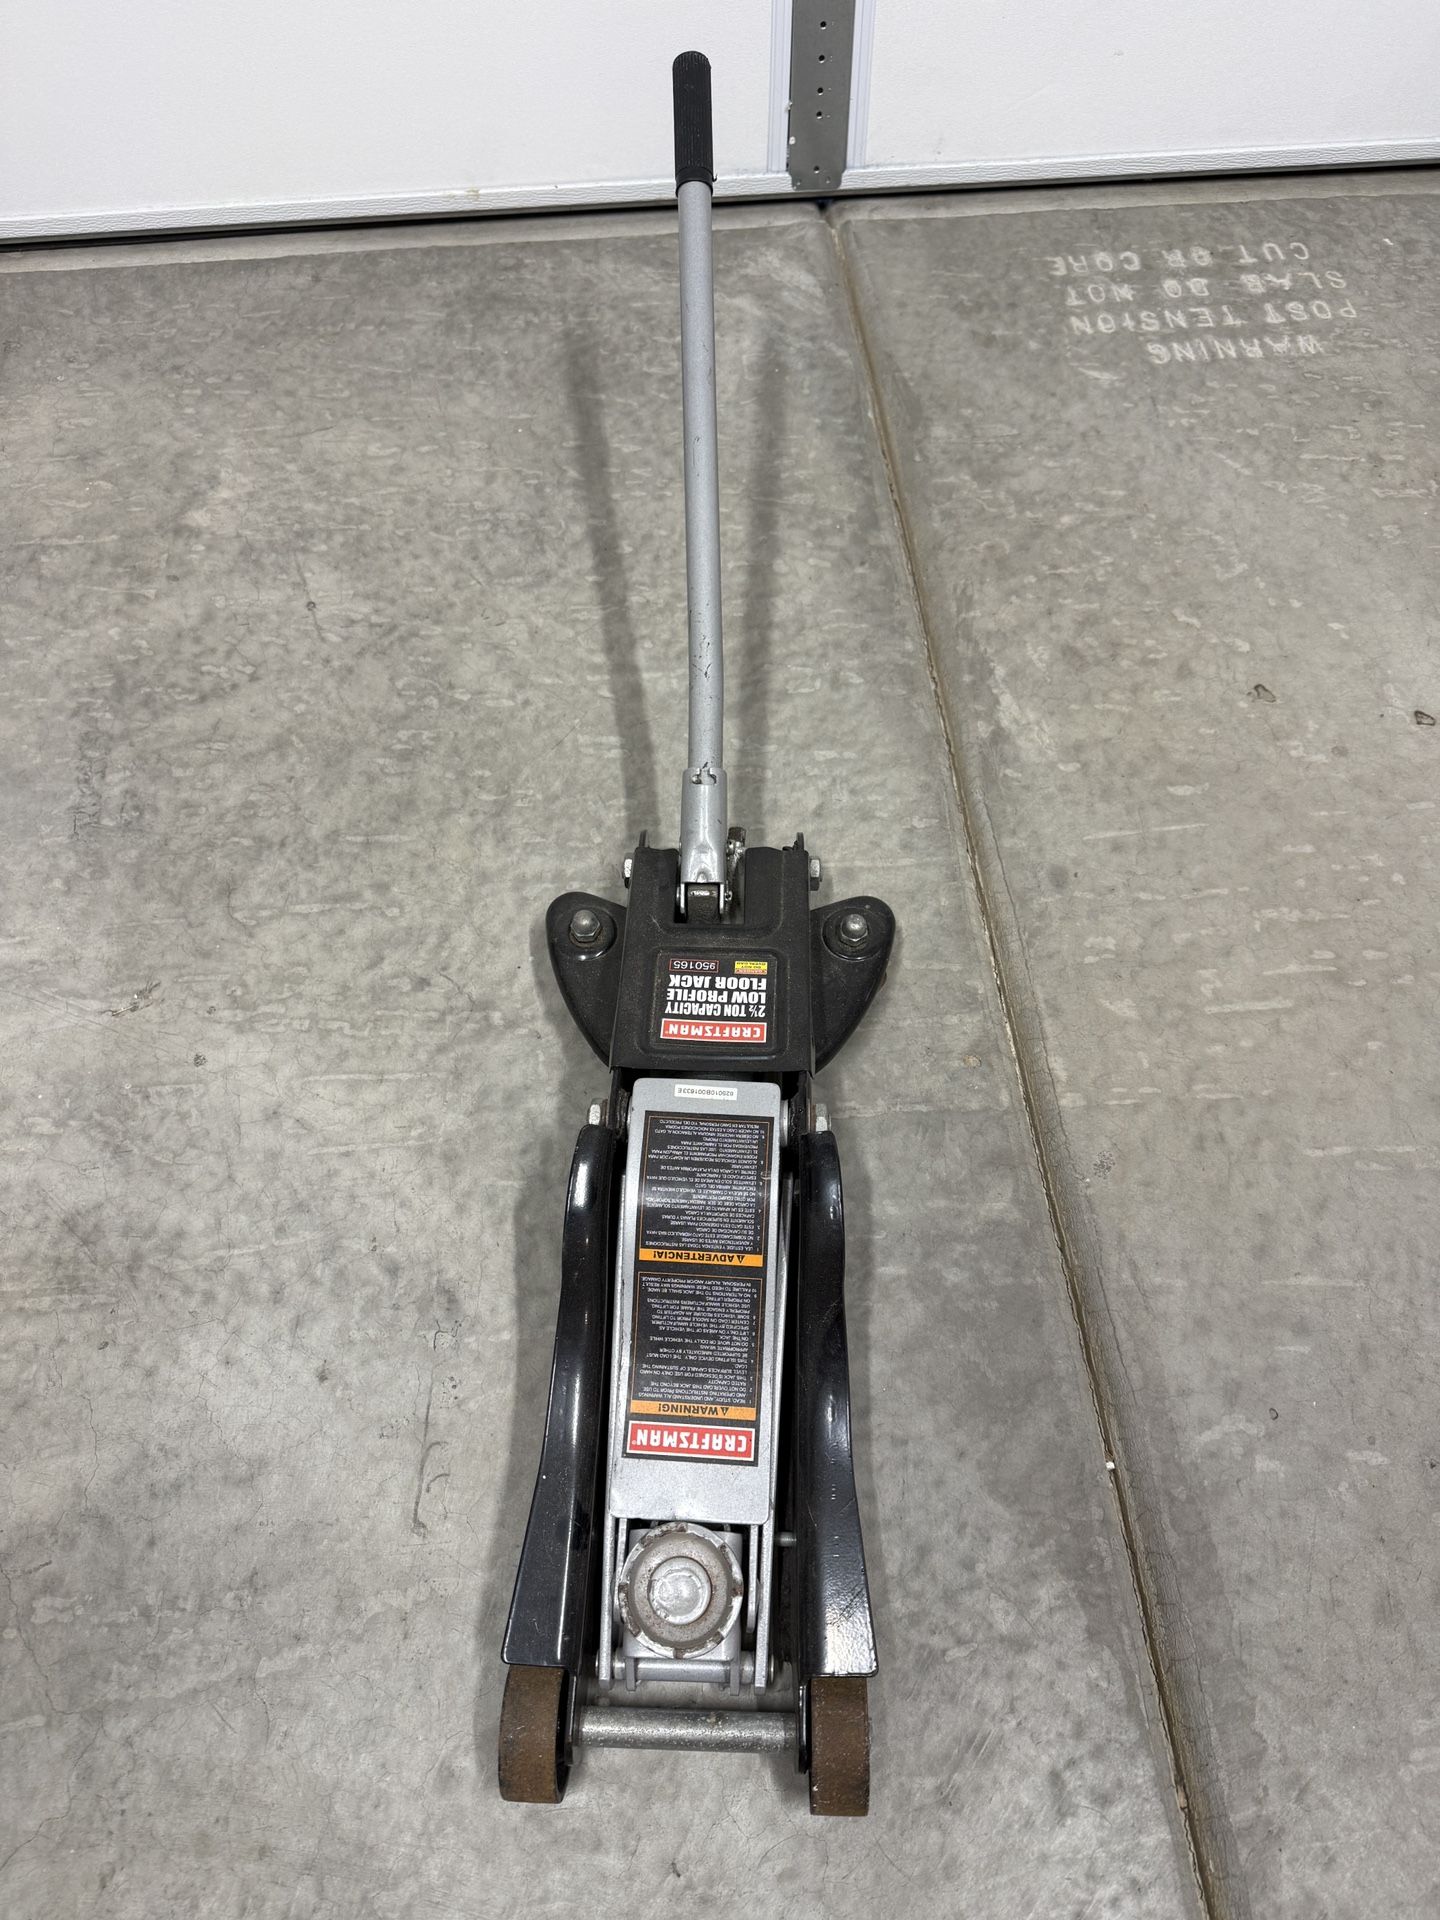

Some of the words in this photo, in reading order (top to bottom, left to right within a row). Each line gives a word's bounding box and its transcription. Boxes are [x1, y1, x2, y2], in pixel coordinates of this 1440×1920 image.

[1162, 246, 1213, 268] OR
[1239, 242, 1310, 264] CUT
[1048, 250, 1142, 276] CORE
[1162, 278, 1210, 298] DO
[1240, 271, 1347, 294] SLAB
[1066, 283, 1135, 306] NOT
[1070, 305, 1248, 335] TENSION
[1264, 300, 1357, 324] POST
[1147, 334, 1324, 364] WARNING
[673, 960, 716, 970] 950165
[668, 974, 712, 988] JACK
[715, 976, 767, 990] FLOOR
[666, 988, 728, 1003] PROFILE
[731, 991, 766, 1004] LOW
[664, 1001, 721, 1017] CAPACITY
[723, 1004, 747, 1017] TON
[668, 1023, 761, 1038] CRAFTSMAN
[653, 1250, 735, 1263] ADVERTENCIA!
[658, 1402, 719, 1416] WARNING!
[636, 1429, 747, 1452] CRAFTSMAN
